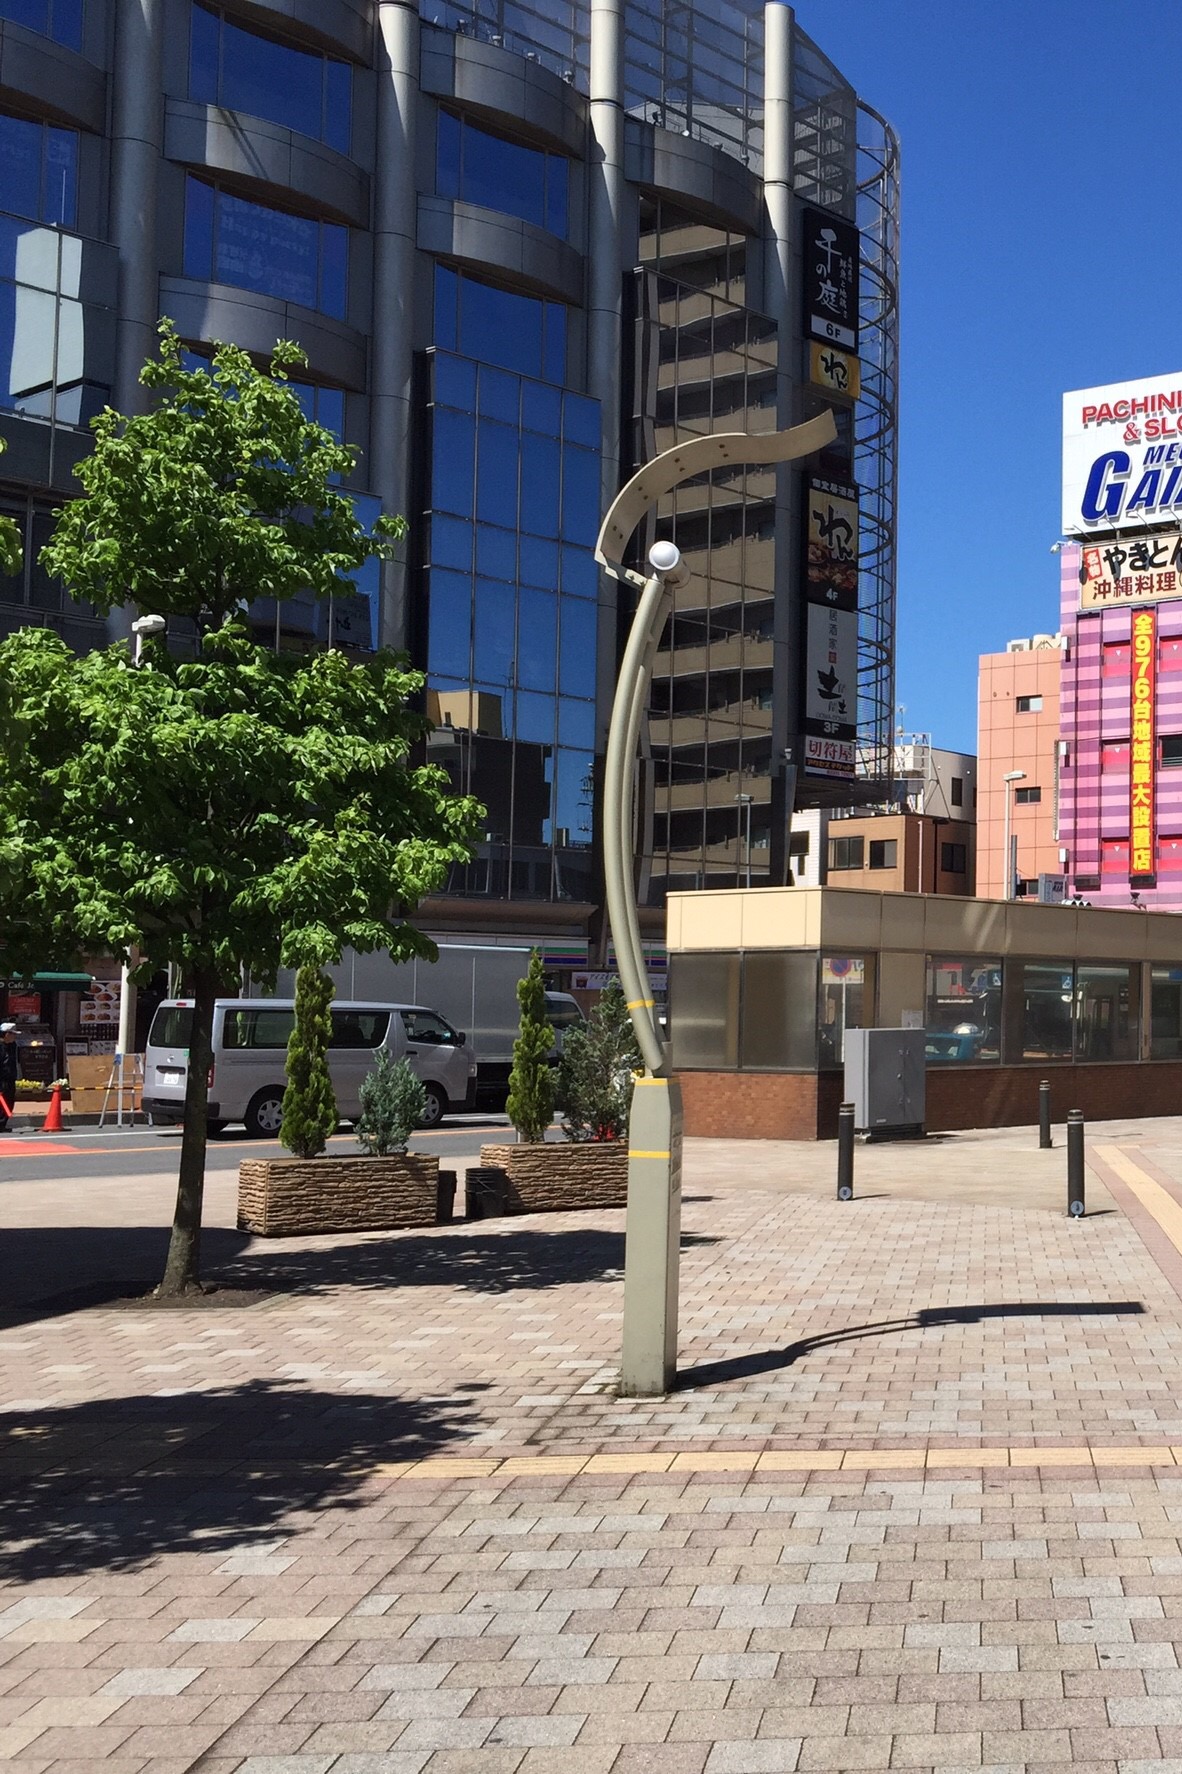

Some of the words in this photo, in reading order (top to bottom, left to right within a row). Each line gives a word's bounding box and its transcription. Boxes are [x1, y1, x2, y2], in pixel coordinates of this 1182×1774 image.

[815, 228, 842, 314] 千の庭
[825, 322, 841, 339] 6F
[1122, 422, 1140, 443] &
[825, 588, 839, 602] 4F
[1092, 570, 1177, 600] 沖縄料理
[823, 721, 840, 734] 3F
[809, 740, 853, 762] 切符屋
[1132, 614, 1153, 871] 全976台地域最大設置店
